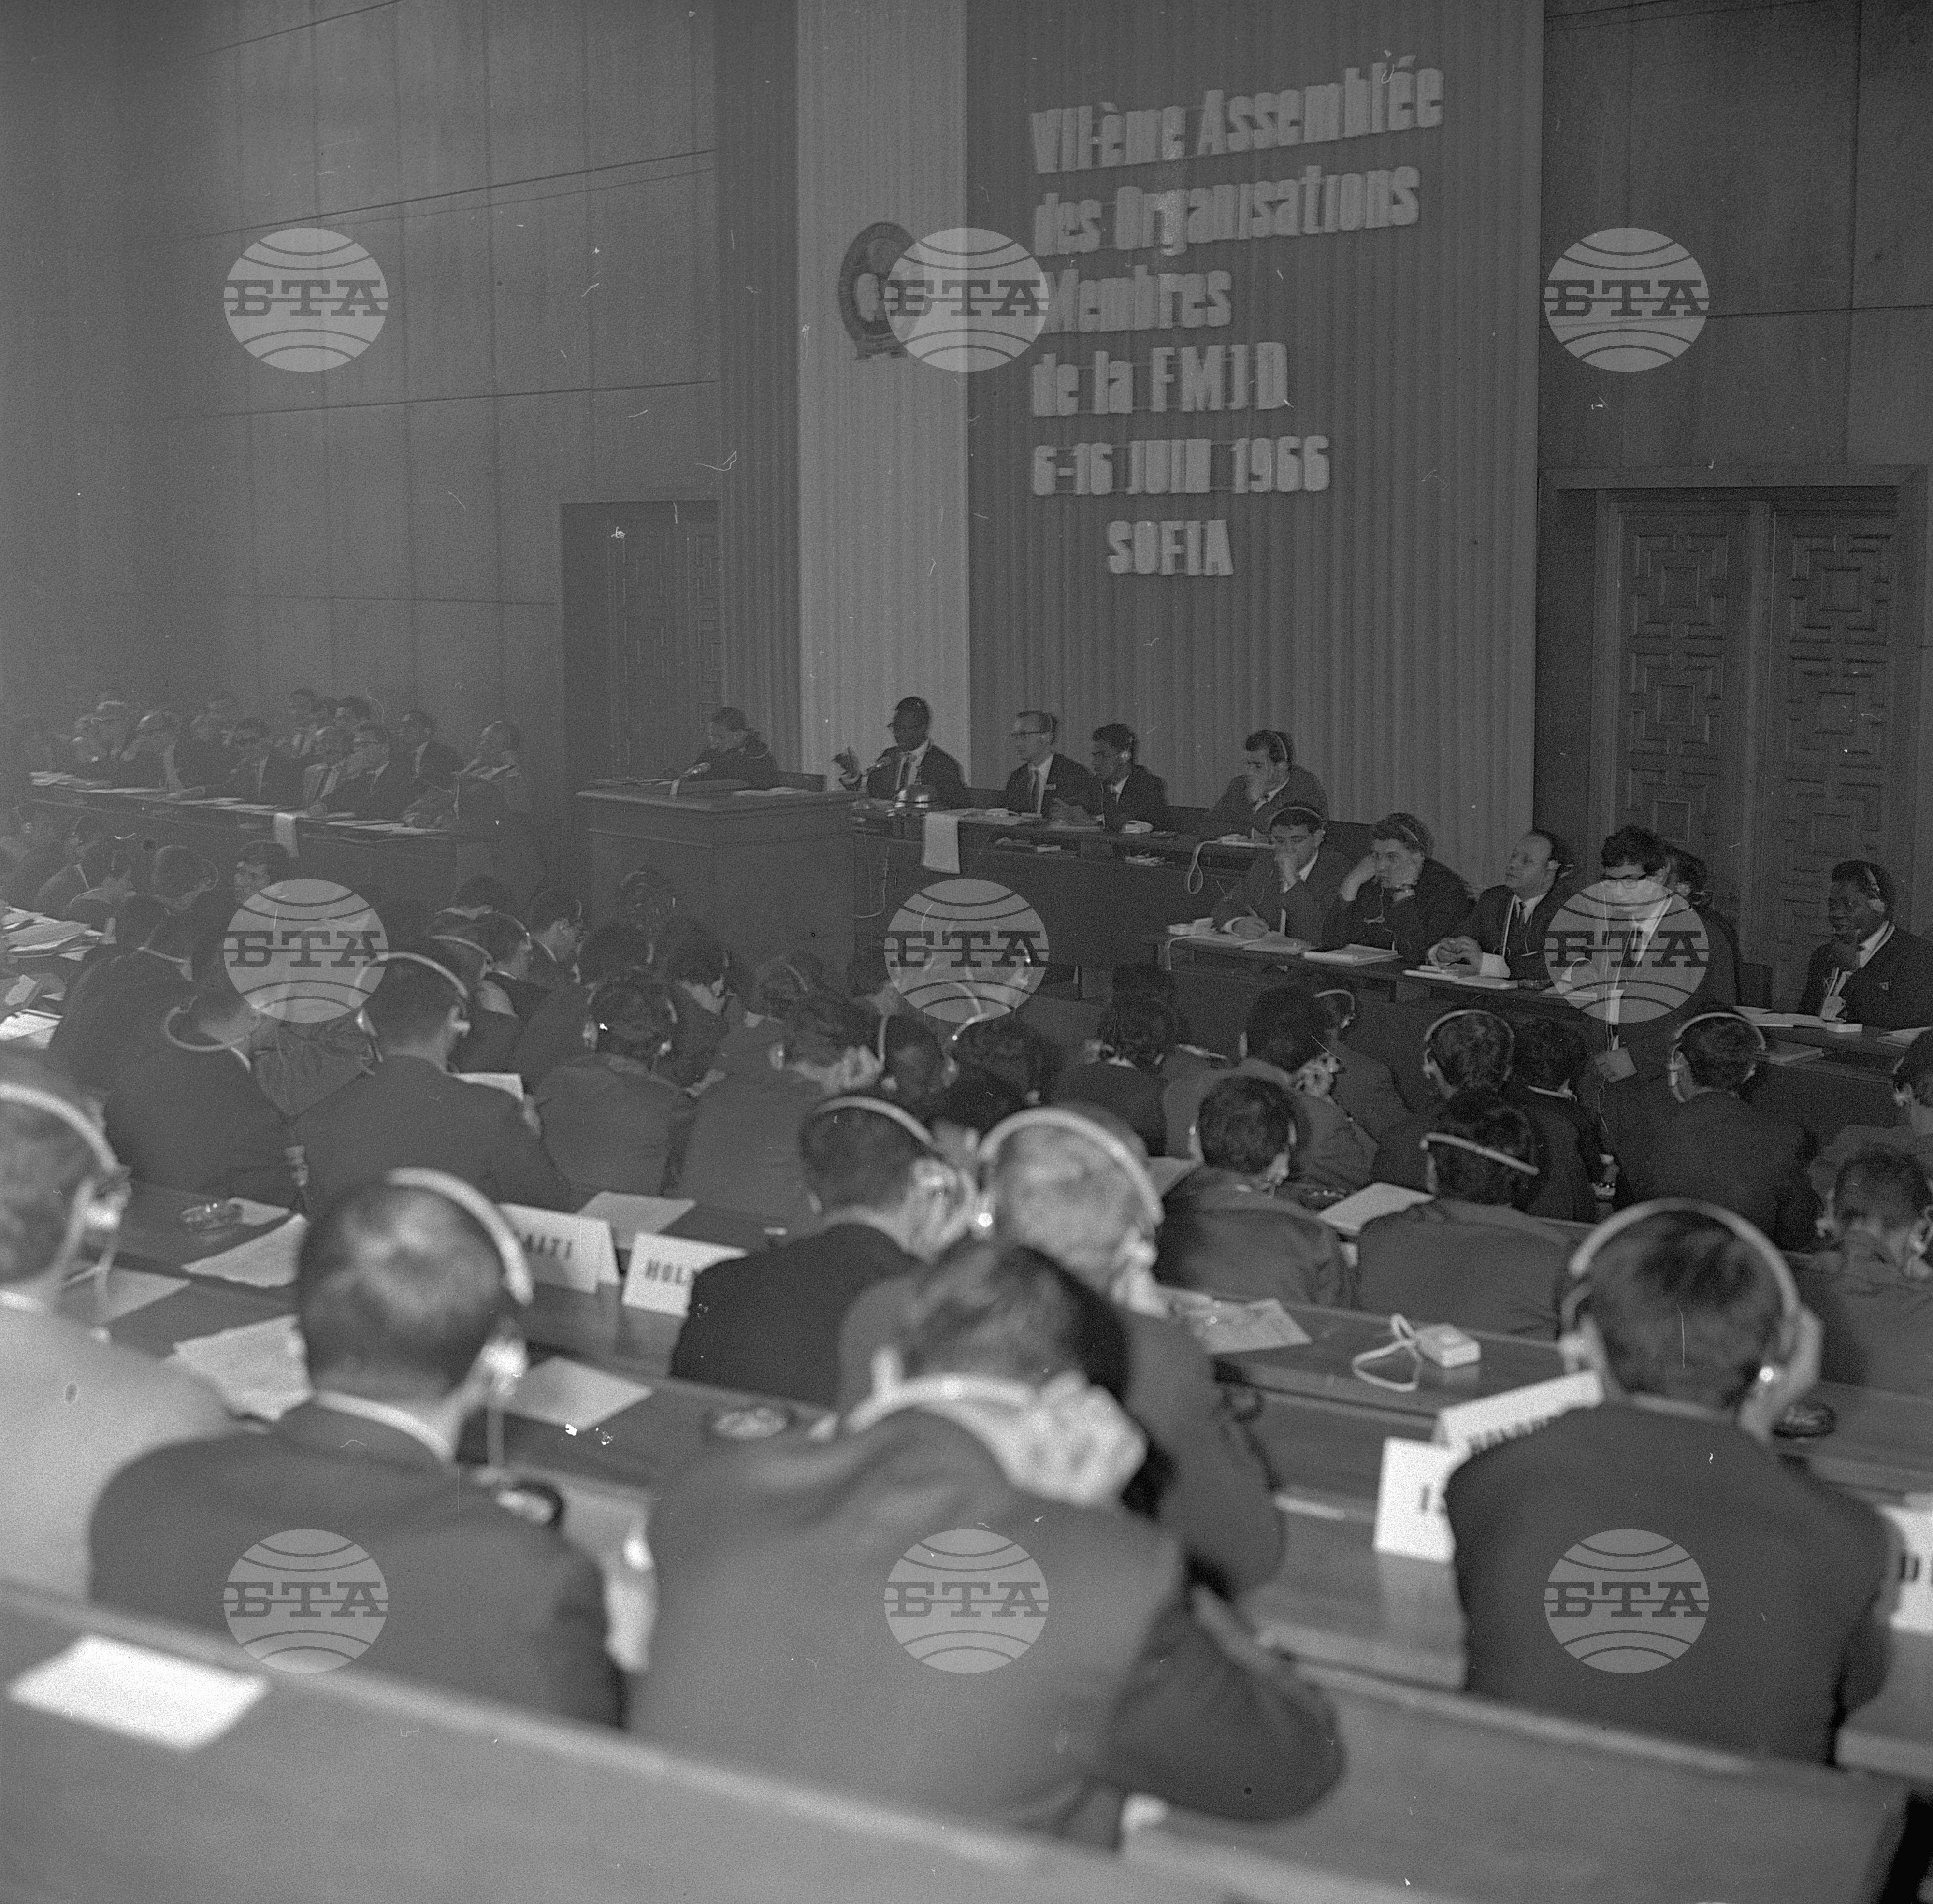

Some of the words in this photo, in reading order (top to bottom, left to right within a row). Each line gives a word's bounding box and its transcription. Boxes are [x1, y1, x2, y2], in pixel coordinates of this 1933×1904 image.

[1198, 54, 1444, 156] Assemblée
[1033, 193, 1102, 256] des
[1115, 165, 1420, 256] Organisations
[1036, 264, 1232, 333] Membres
[1032, 353, 1079, 417] de
[1093, 350, 1133, 414] la
[1151, 342, 1288, 412] FMJD
[1033, 444, 1113, 495] 6-16
[1126, 438, 1211, 494] JUIN
[1231, 434, 1330, 494] 1966
[1107, 519, 1234, 576] SOFIA
[519, 1233, 573, 1260] AITI
[646, 1258, 687, 1285] HOL
